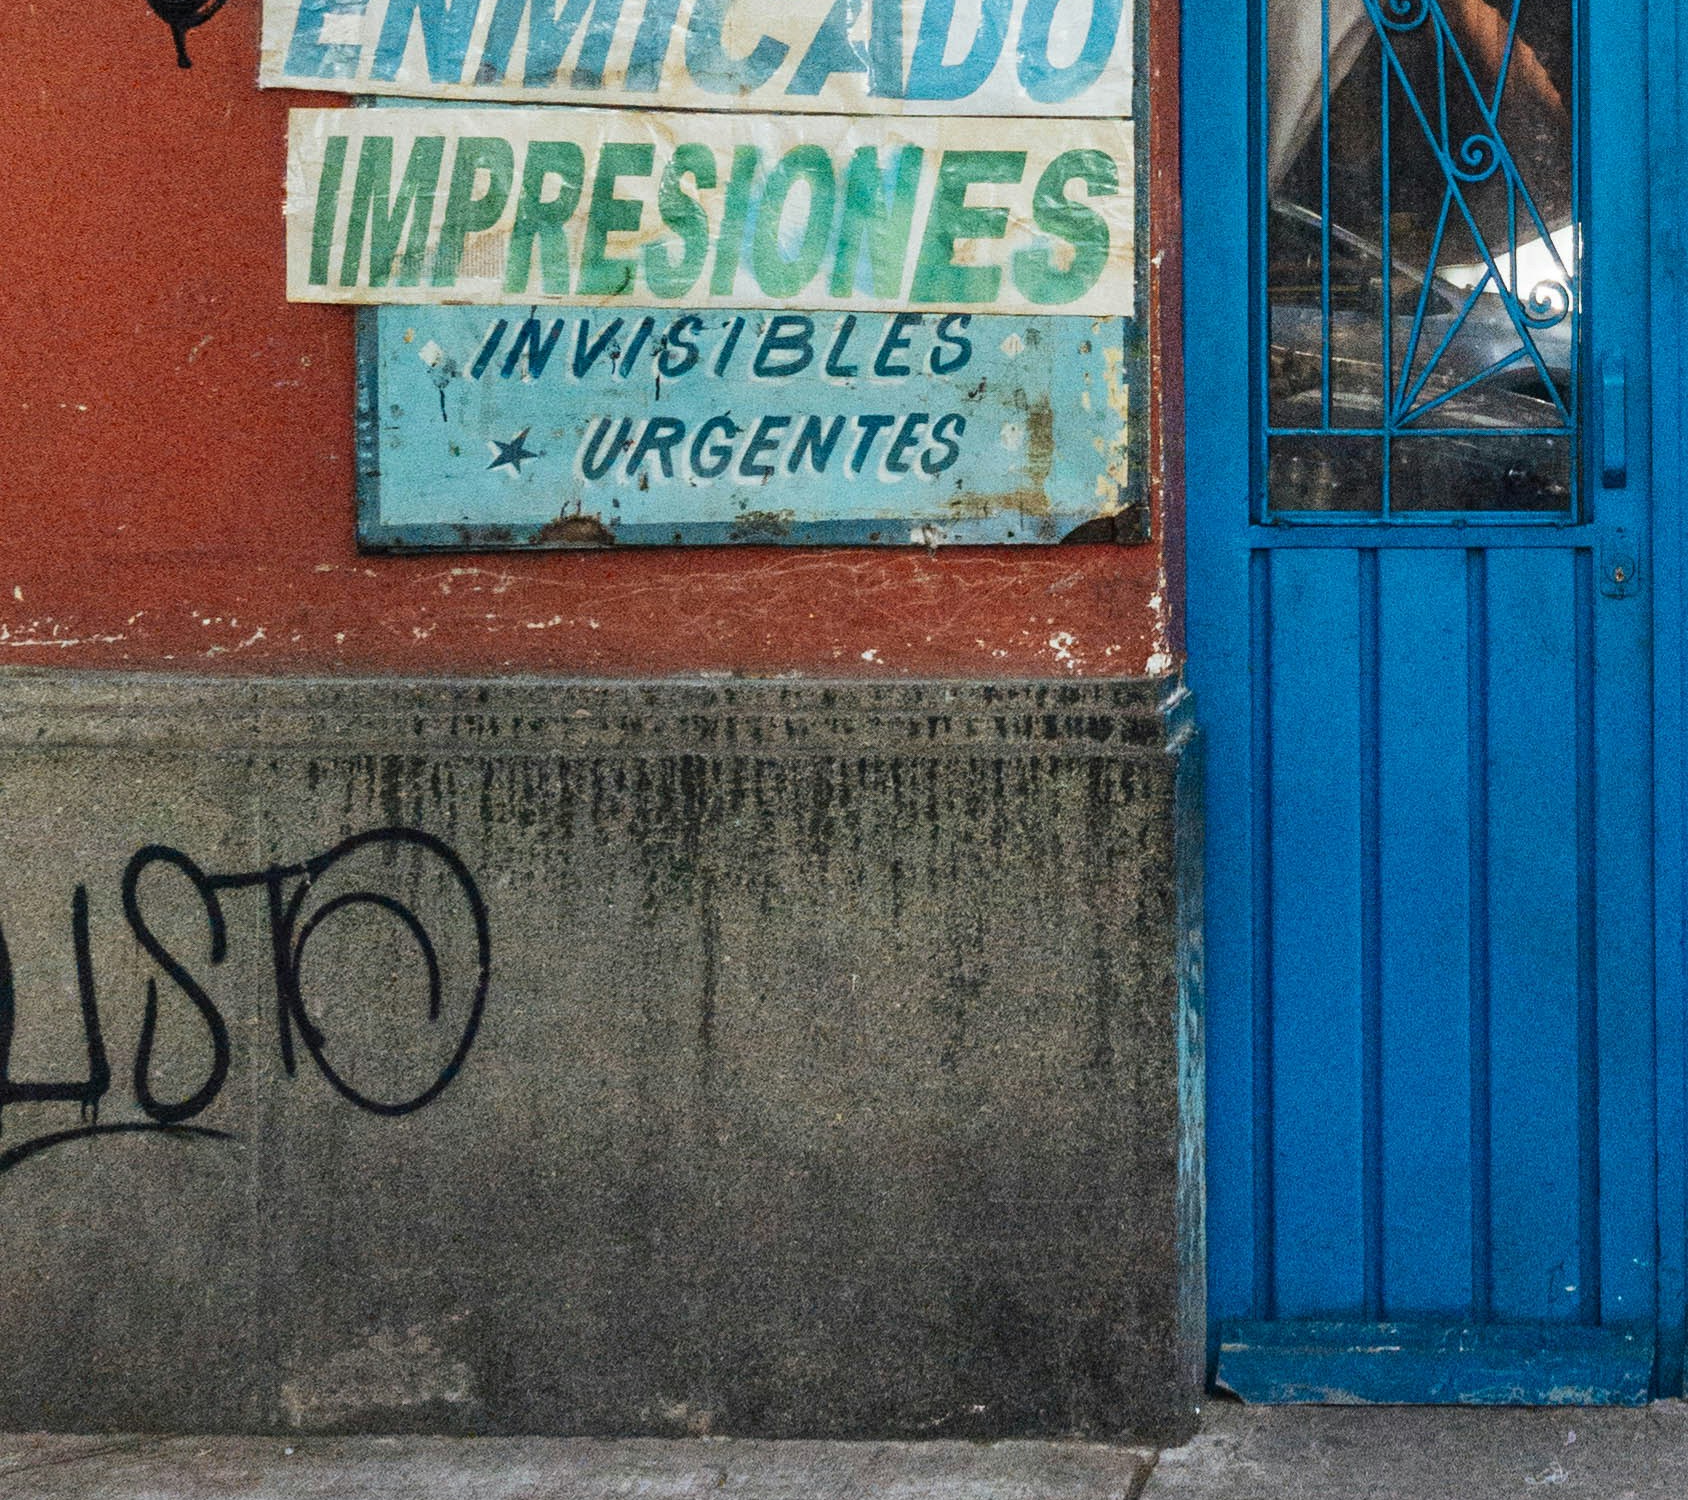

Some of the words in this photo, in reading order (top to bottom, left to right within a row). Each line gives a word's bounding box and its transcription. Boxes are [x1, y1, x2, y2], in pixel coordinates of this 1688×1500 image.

[307, 134, 1124, 304] IMPRESIONES
[470, 312, 975, 381] INVISIBLES
[580, 413, 966, 481] URGENTES
